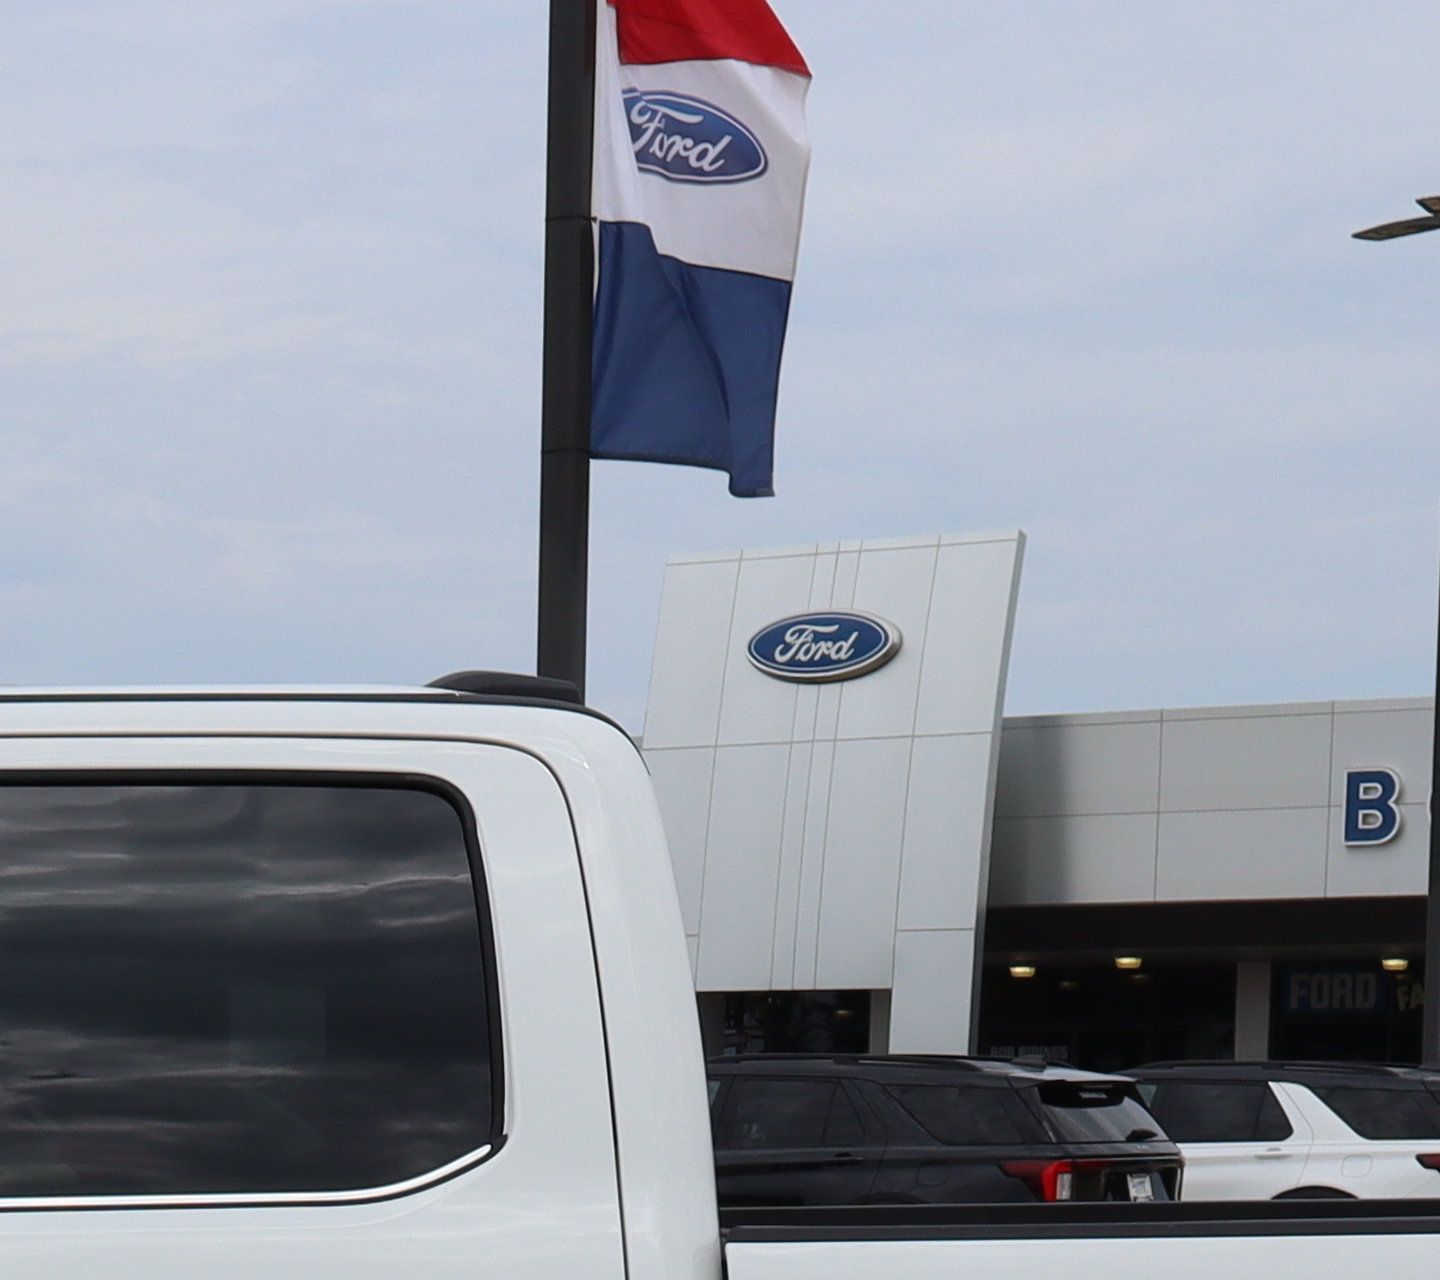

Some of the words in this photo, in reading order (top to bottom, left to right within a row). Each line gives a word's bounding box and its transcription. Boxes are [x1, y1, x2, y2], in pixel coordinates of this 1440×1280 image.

[629, 97, 726, 173] Ford
[774, 623, 860, 664] Ford
[1290, 973, 1377, 1009] FORD
